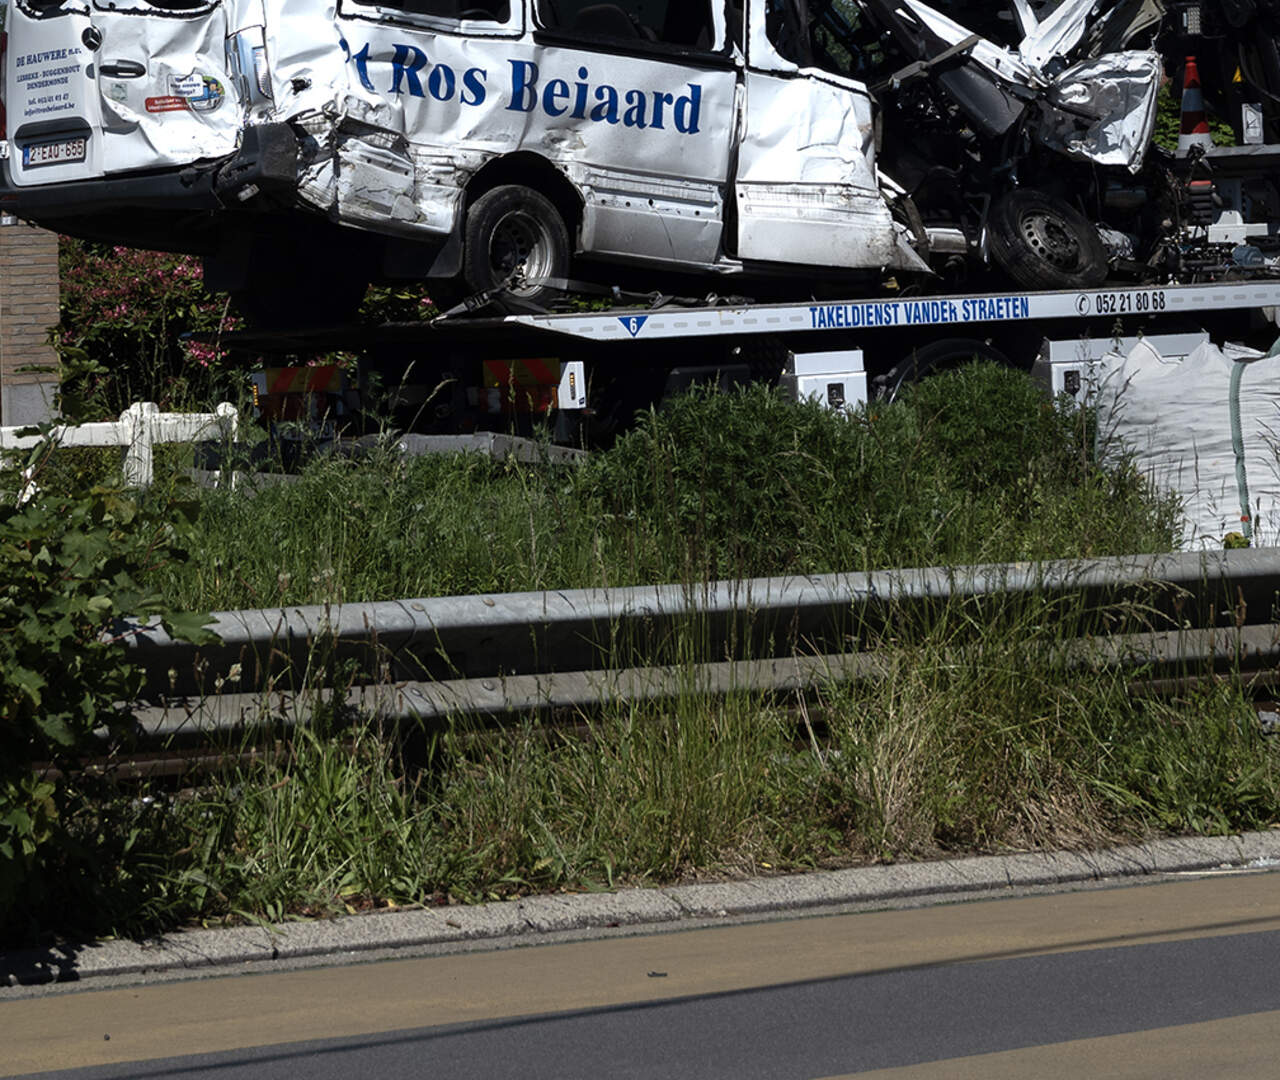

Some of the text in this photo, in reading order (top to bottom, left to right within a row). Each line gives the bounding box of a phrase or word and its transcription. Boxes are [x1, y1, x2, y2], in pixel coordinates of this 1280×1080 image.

[16, 56, 25, 67] DE
[26, 49, 68, 64] HAUWERE
[391, 44, 488, 106] Ros
[505, 59, 702, 135] Beiaard
[810, 297, 1029, 328] TAKELDIENST VANDER STRAETEN
[1096, 291, 1165, 313] 052 21 80 68
[630, 317, 638, 333] 6
